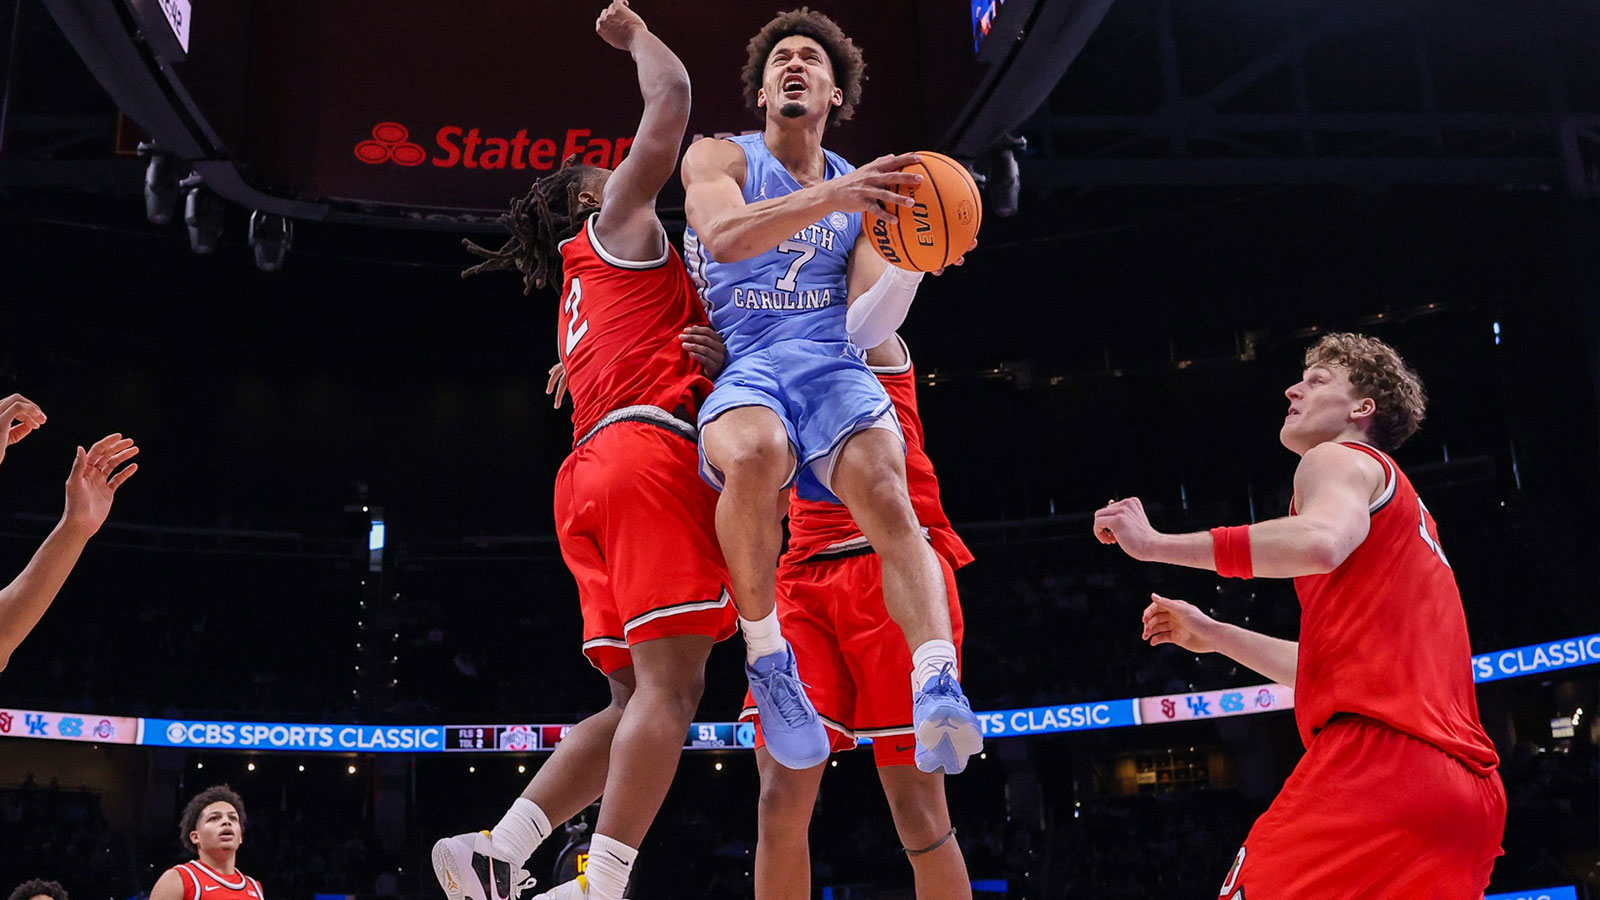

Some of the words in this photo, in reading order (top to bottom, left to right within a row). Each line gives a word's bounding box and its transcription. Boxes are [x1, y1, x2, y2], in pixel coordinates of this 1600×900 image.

[432, 126, 557, 170] State
[562, 128, 634, 170] Far
[775, 240, 817, 293] 7
[733, 287, 832, 310] CAROLINA
[564, 277, 590, 357] 2
[1010, 704, 1110, 732] CLASSIC
[187, 723, 236, 745] CBS
[239, 725, 334, 748] SPORTS
[338, 727, 439, 749] CLASSIC
[698, 724, 717, 741] 51
